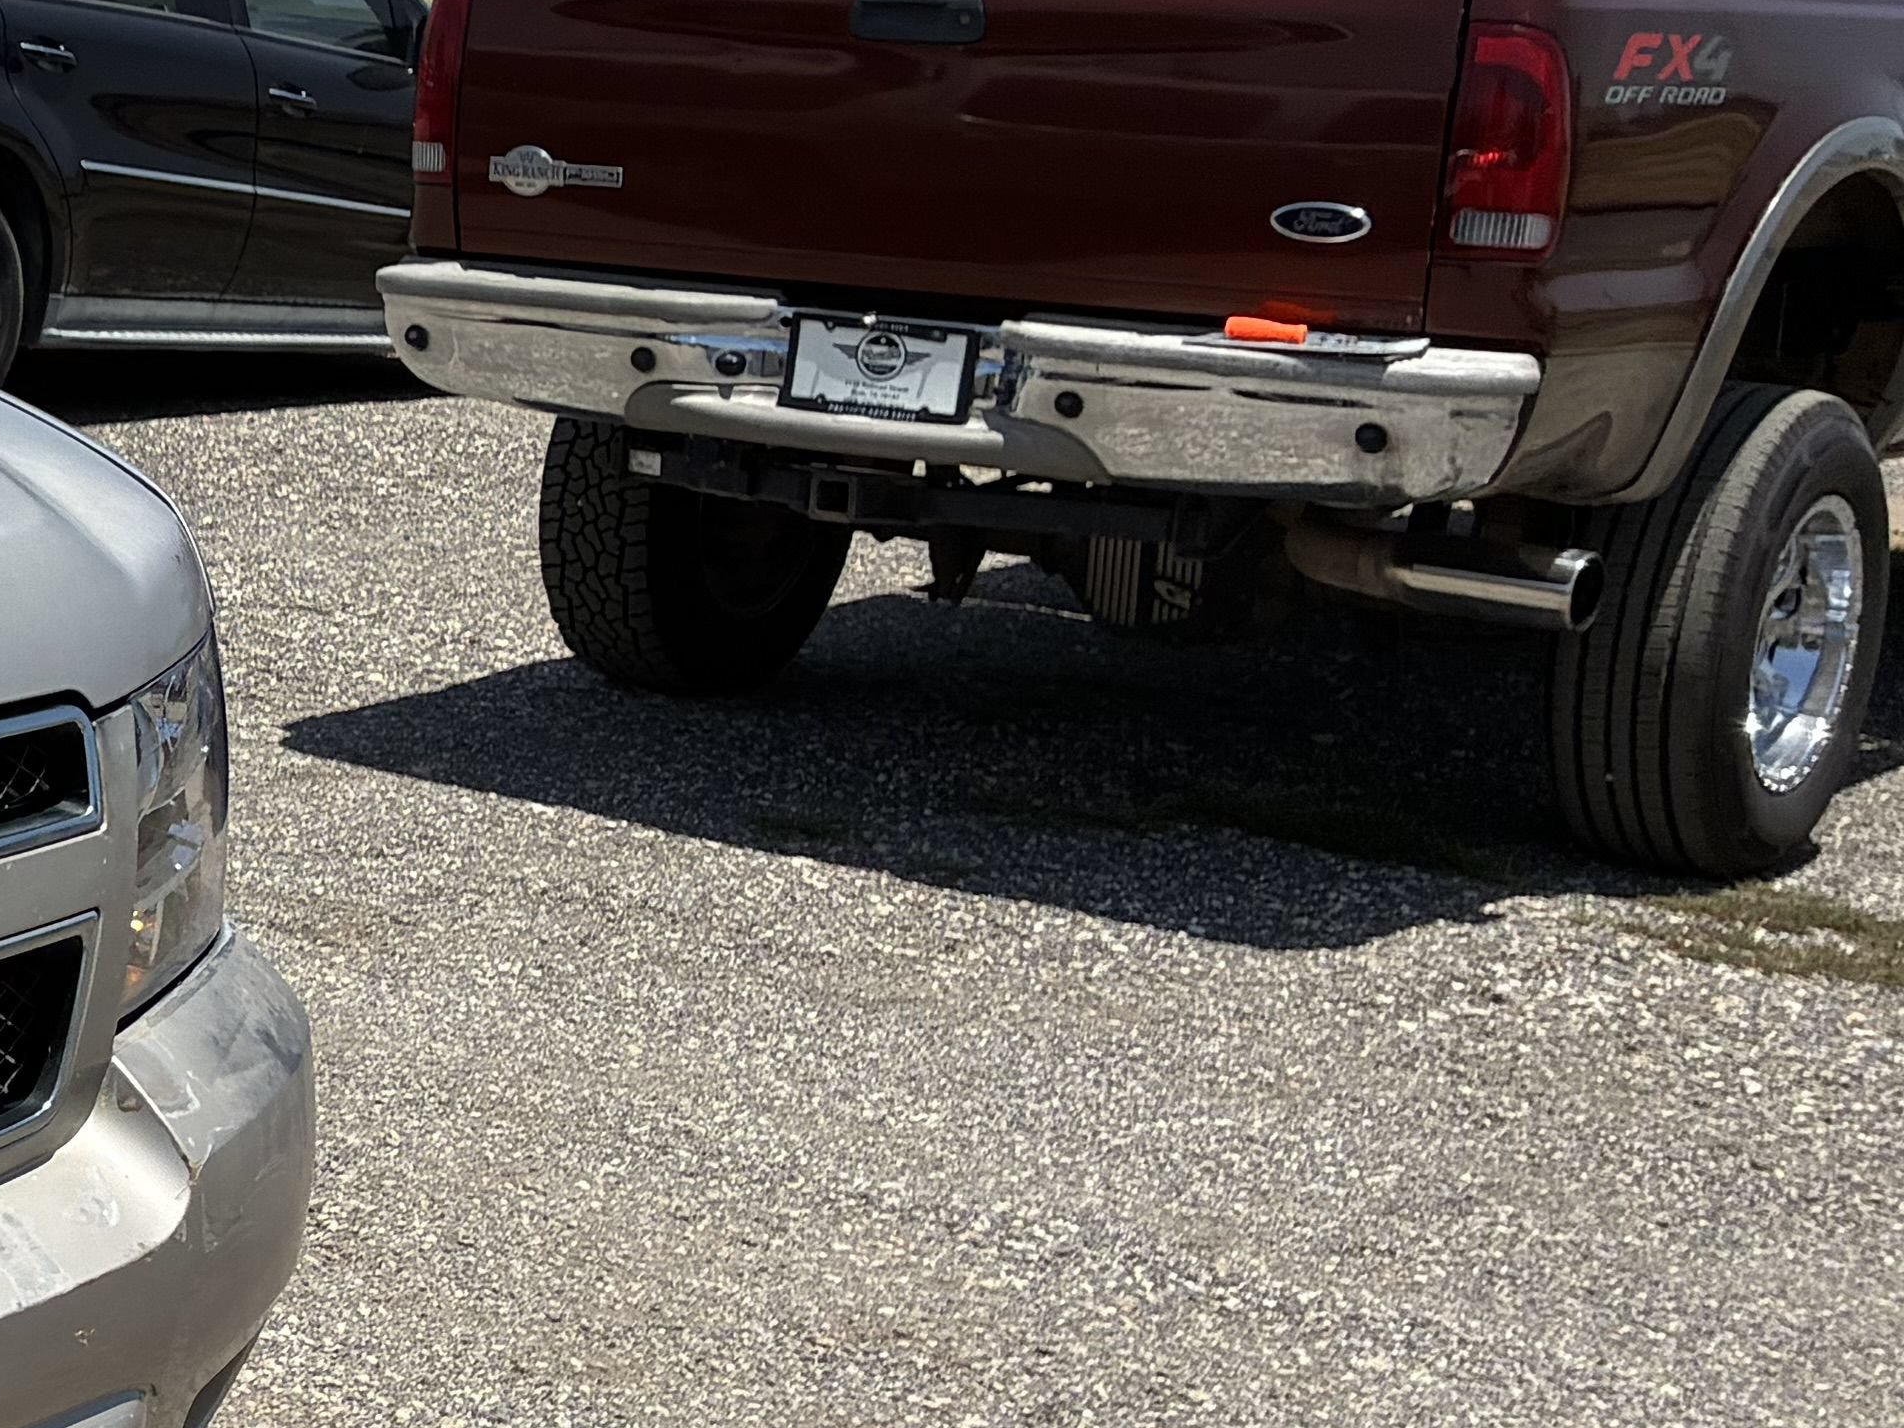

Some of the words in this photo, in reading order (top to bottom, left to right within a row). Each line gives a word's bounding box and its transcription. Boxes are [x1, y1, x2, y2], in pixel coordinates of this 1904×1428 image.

[1613, 32, 1733, 82] FX4
[1605, 85, 1655, 105] OFF
[1659, 85, 1727, 106] ROAD
